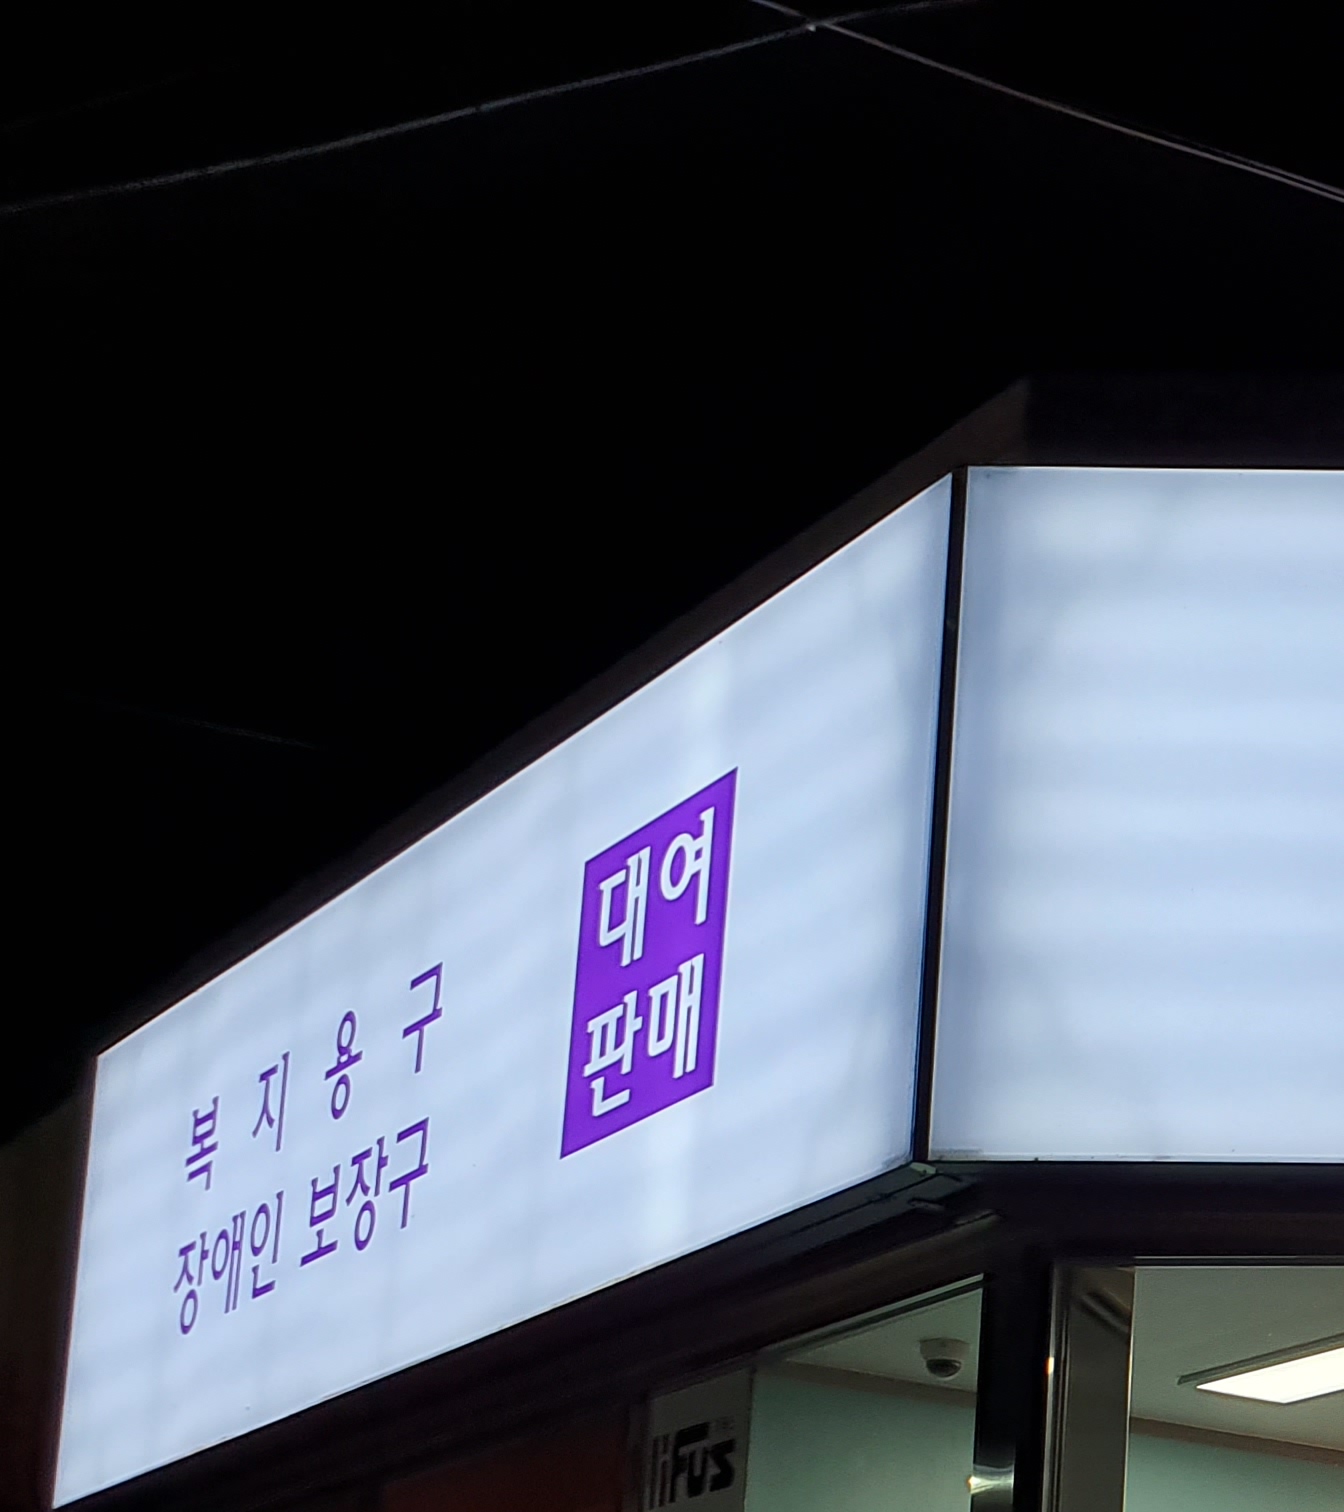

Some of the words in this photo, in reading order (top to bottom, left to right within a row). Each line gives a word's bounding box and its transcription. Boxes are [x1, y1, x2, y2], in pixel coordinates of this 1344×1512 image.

[598, 806, 716, 967] 대여
[584, 952, 705, 1117] 판매
[172, 1191, 285, 1335] 장애인
[300, 1116, 431, 1270] 보장구
